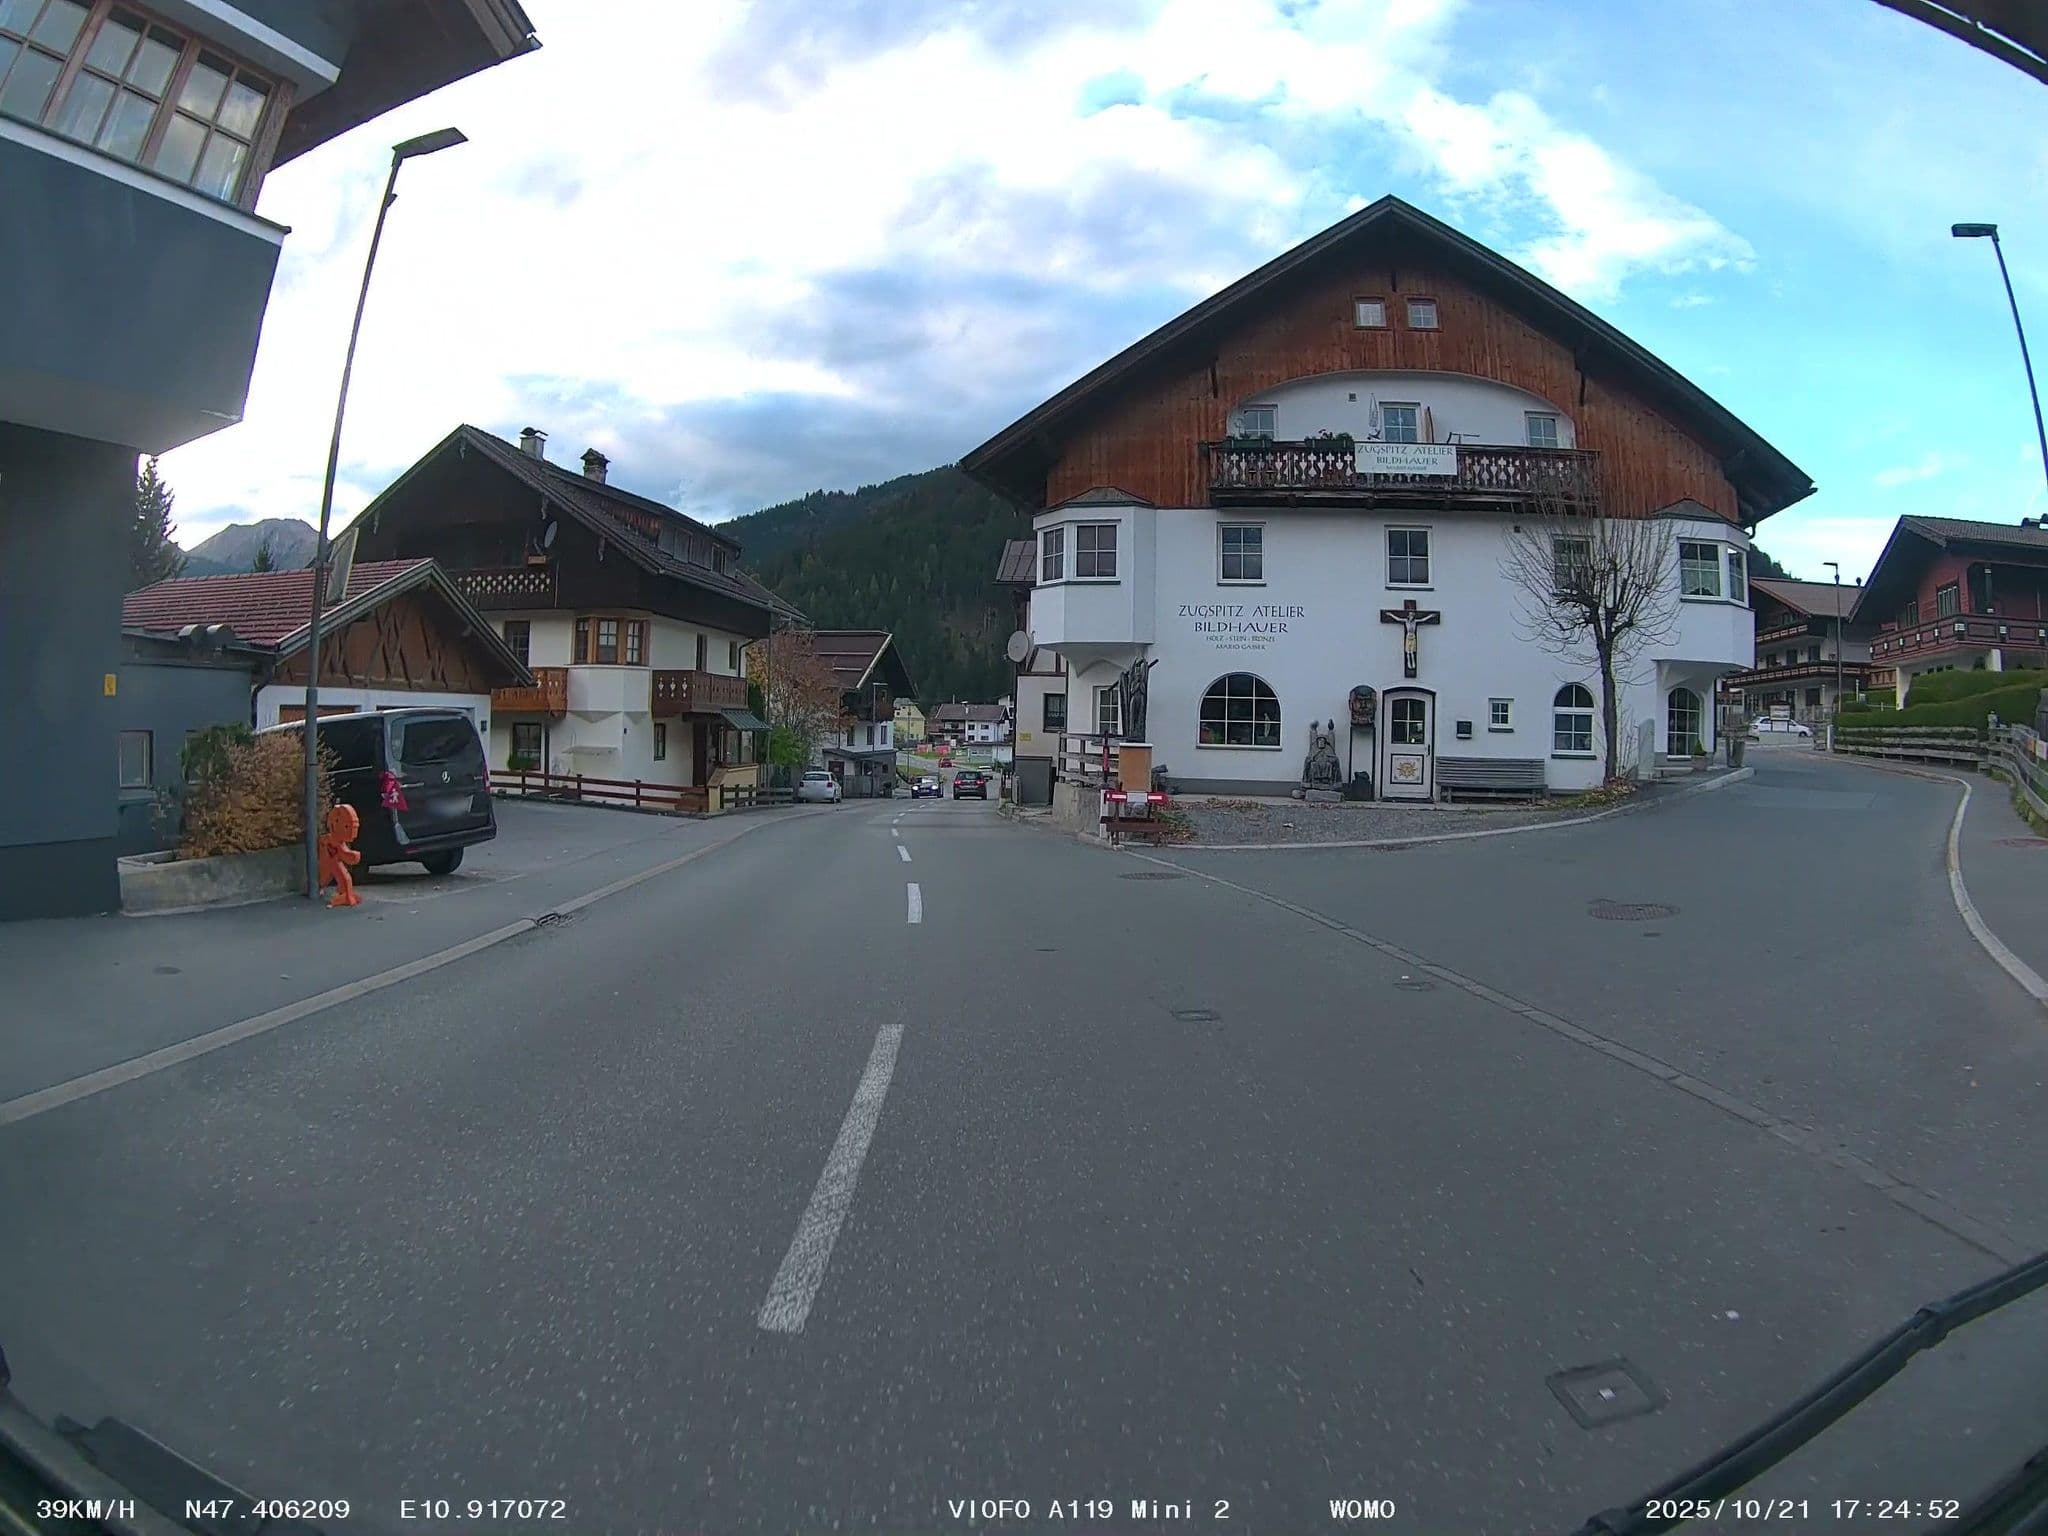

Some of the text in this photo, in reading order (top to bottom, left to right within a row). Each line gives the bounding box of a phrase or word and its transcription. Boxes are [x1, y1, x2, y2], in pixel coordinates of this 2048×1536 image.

[1357, 444, 1454, 456] ZUGSPITZ ATELIER
[1376, 456, 1439, 465] BILDHAUER
[1178, 605, 1305, 619] ZUGSPITZ ATELIER
[1194, 621, 1289, 633] BILDHAUER
